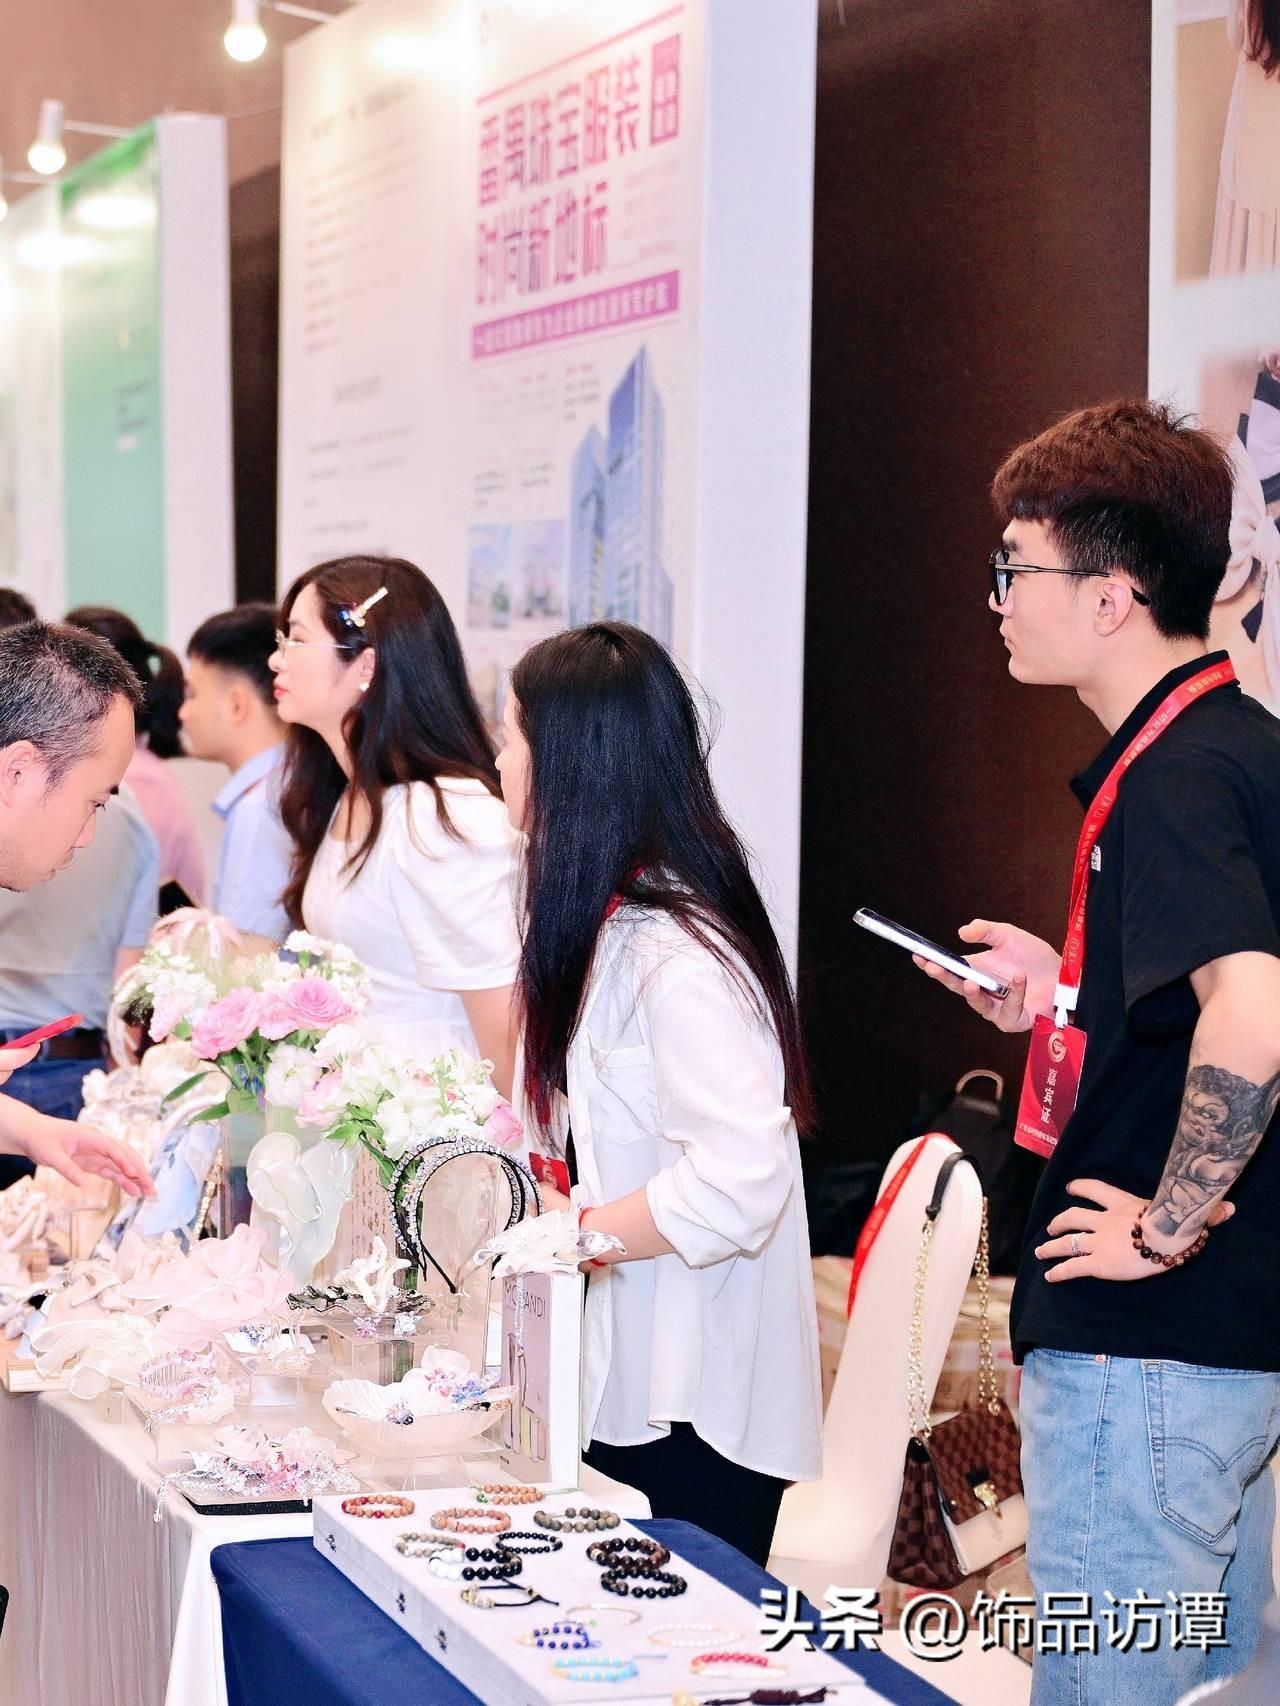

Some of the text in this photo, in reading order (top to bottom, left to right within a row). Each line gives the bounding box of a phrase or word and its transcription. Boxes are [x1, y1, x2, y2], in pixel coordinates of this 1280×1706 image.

[475, 181, 609, 306] 时尚新地标
[1039, 1067, 1058, 1125] 嘉宾证
[504, 1280, 547, 1320] MOANDI
